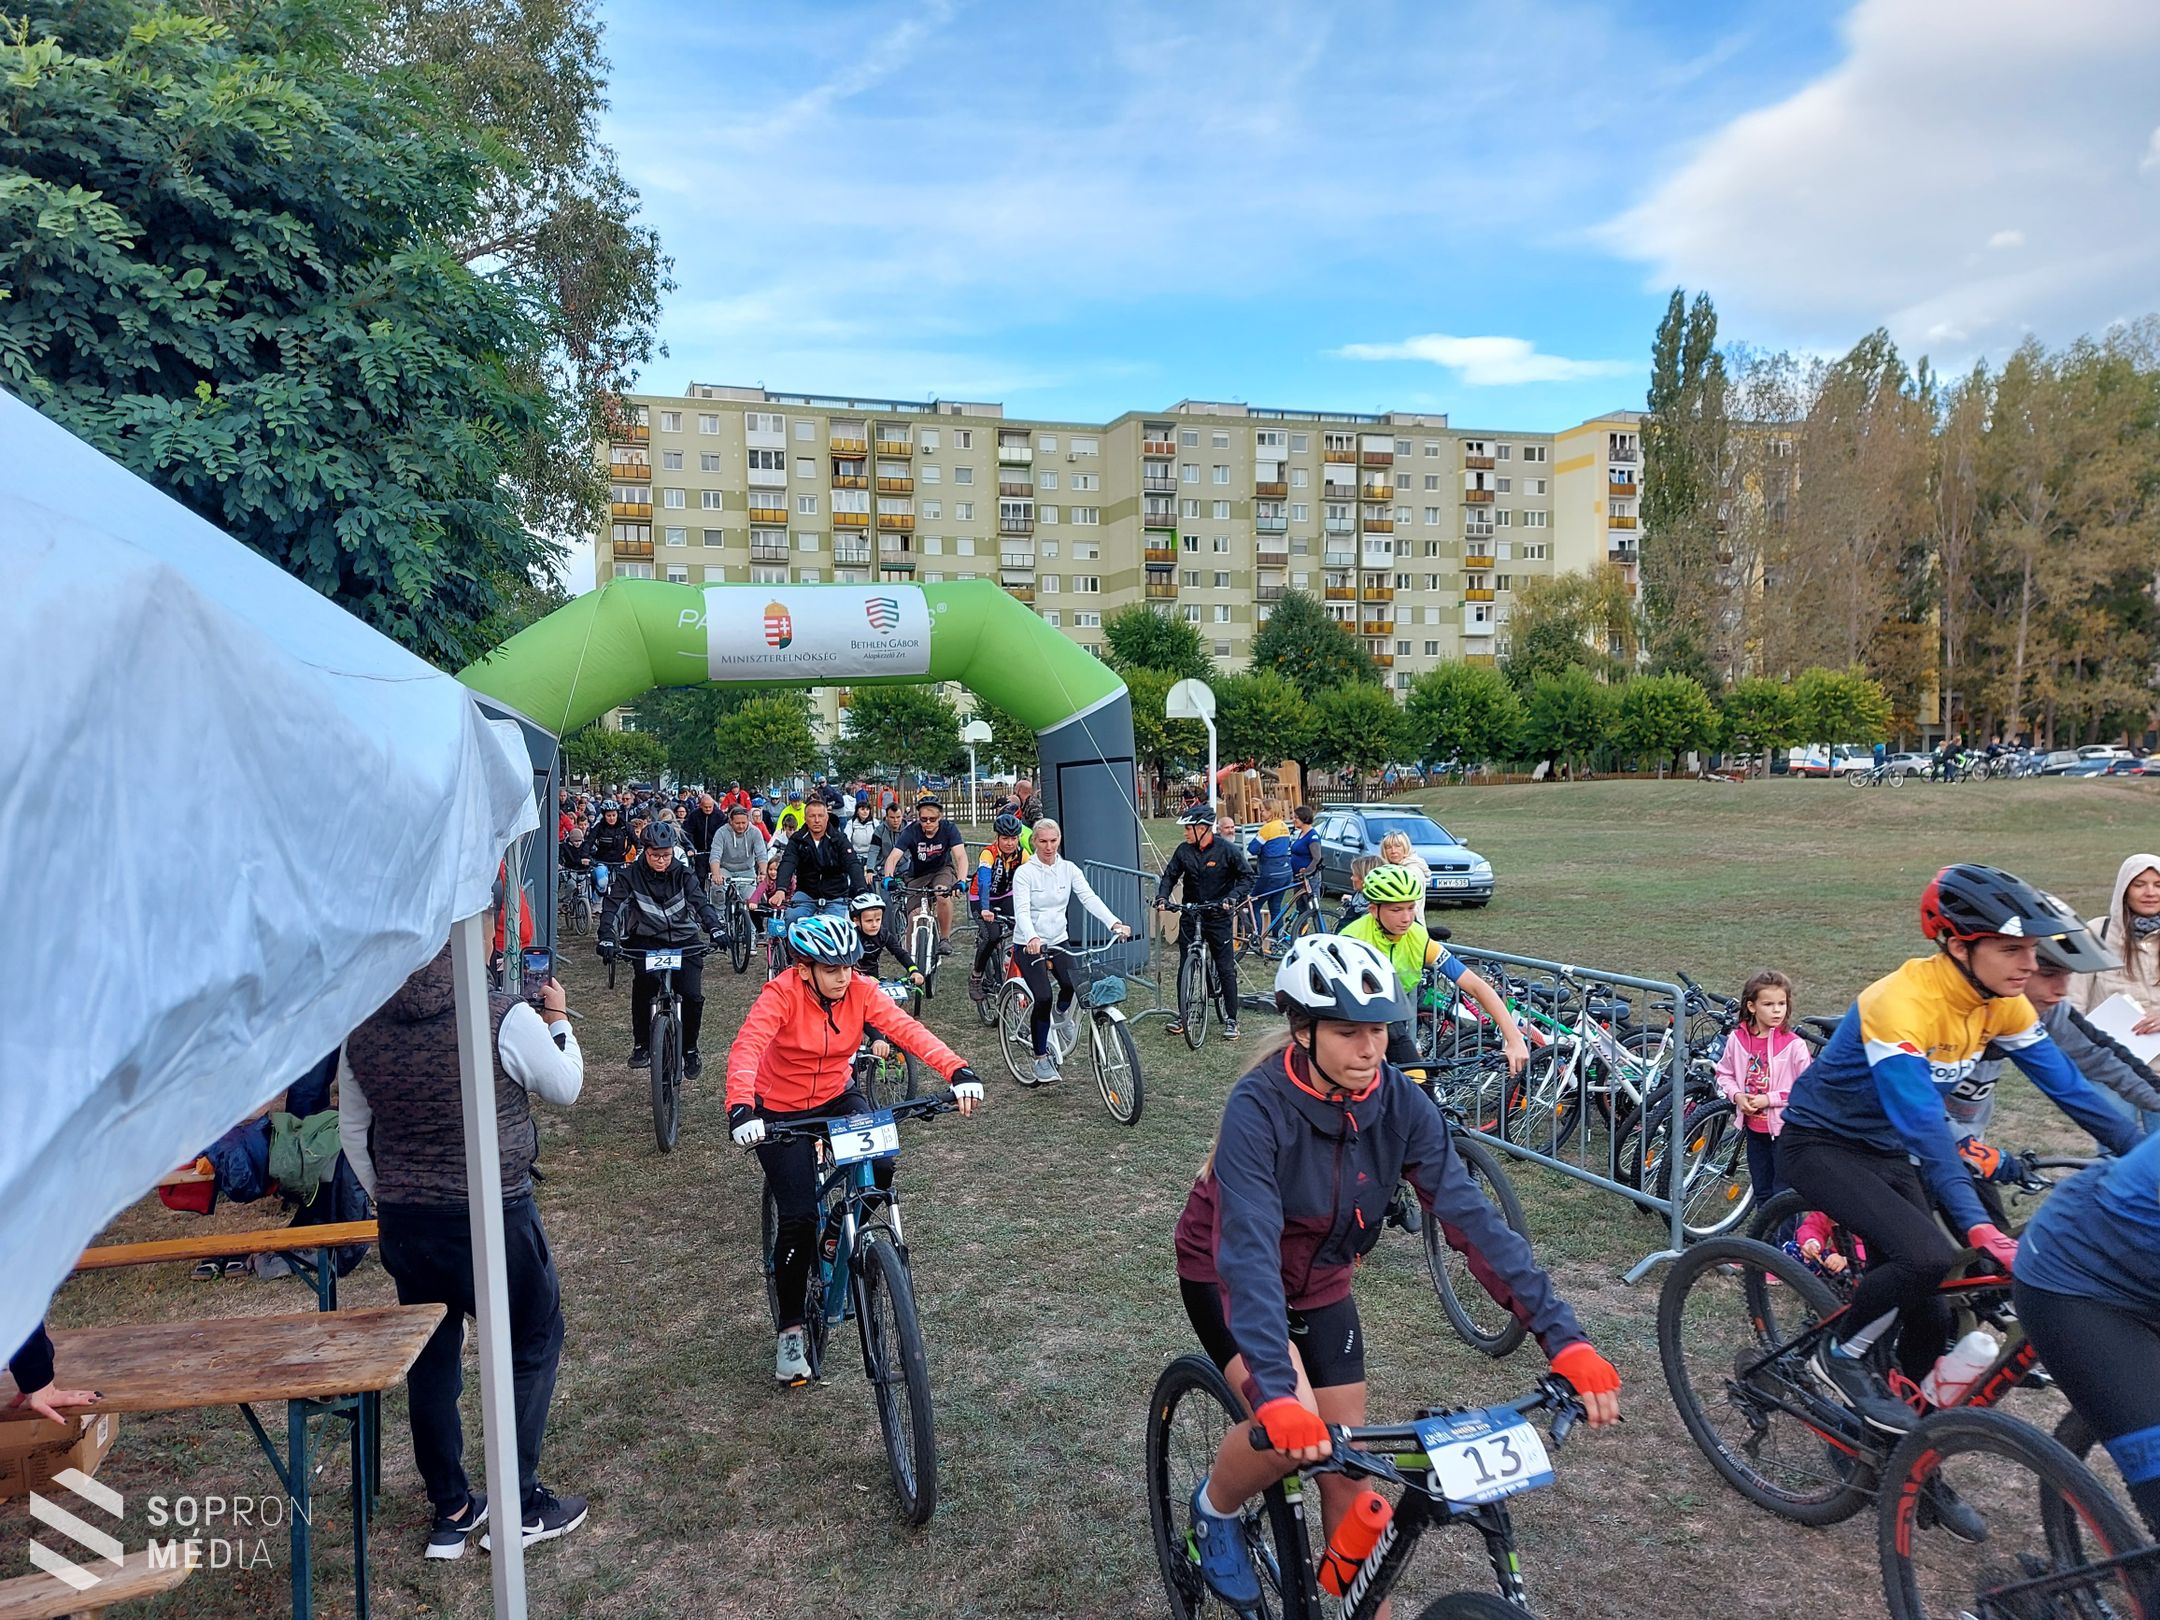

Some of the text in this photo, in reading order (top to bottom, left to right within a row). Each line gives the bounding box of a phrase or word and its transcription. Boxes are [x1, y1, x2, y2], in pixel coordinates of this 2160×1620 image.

[851, 640, 887, 649] BETHLEN
[720, 652, 837, 664] MINISZTERELNÖKSÉG
[654, 956, 672, 967] 24
[885, 987, 901, 997] 11
[857, 1131, 875, 1152] 3
[1462, 1435, 1522, 1486] 13
